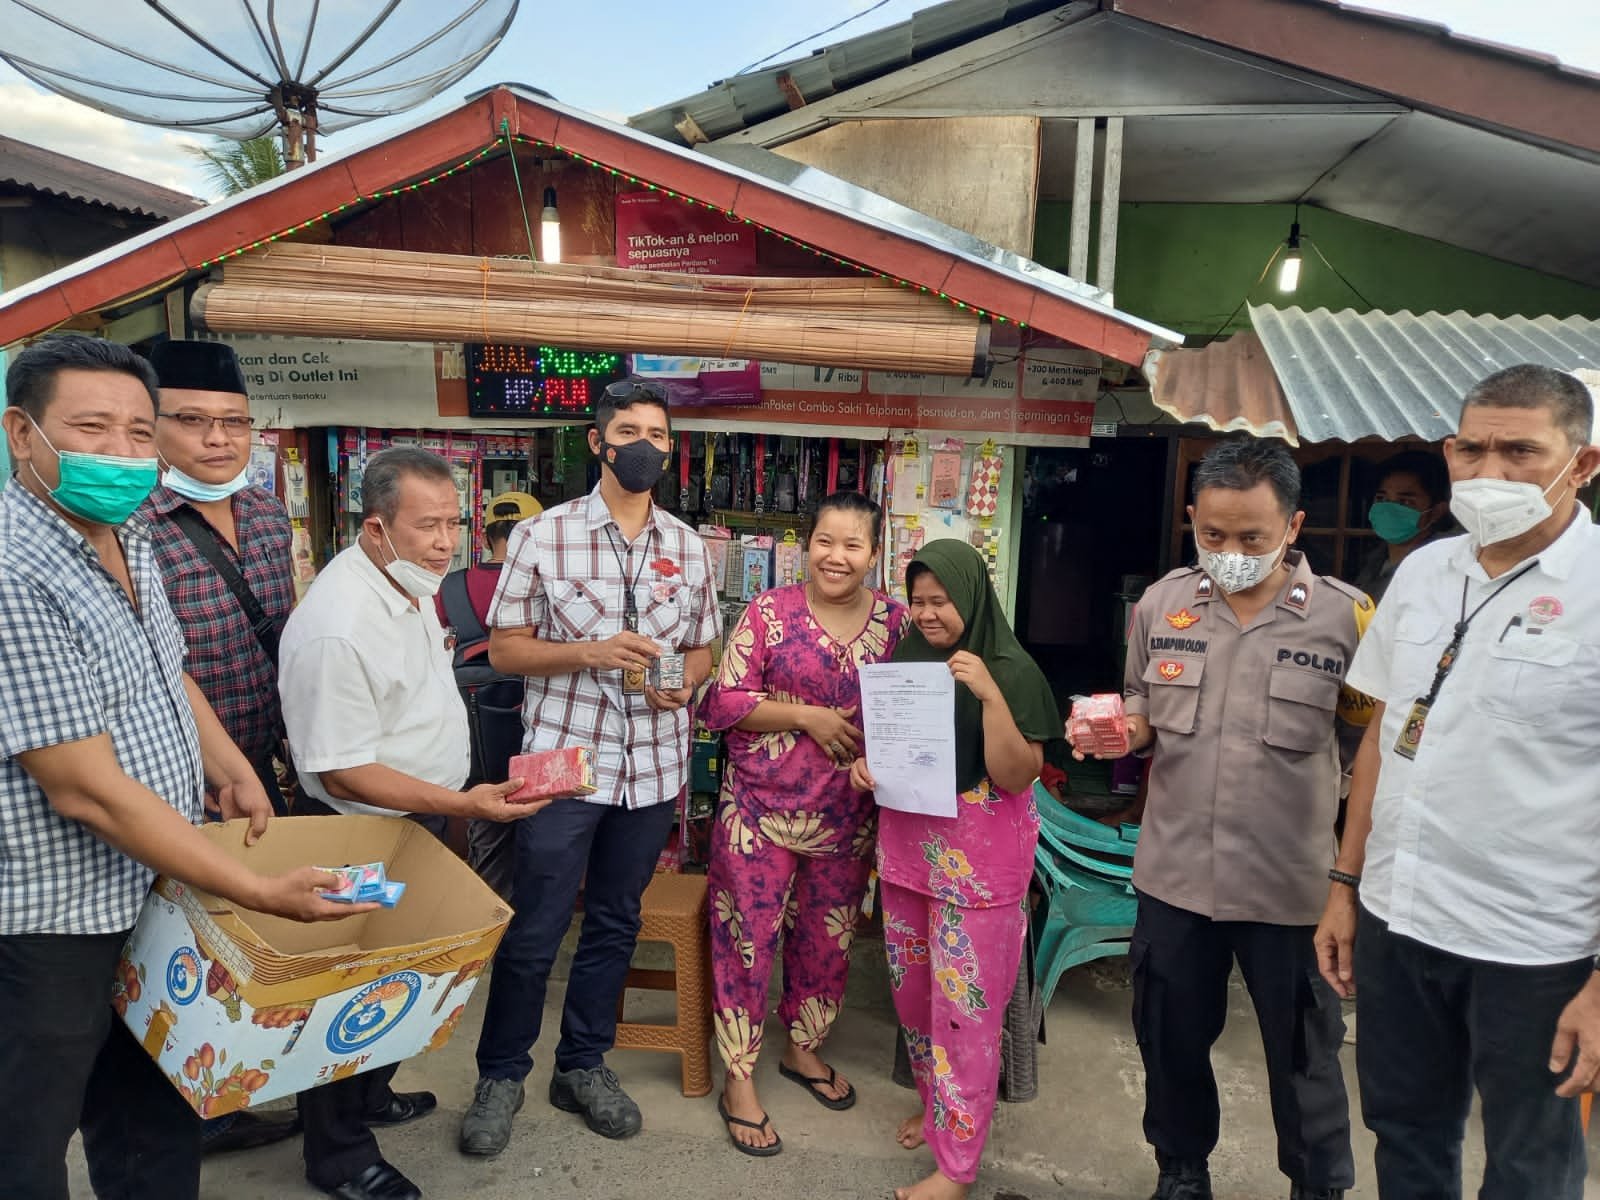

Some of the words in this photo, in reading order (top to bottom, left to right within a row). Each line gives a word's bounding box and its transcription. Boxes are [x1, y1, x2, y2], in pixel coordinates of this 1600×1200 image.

[628, 235, 685, 247] TikTok-an
[687, 233, 697, 243] &
[698, 231, 739, 244] nelpon
[628, 247, 690, 261] sepuasnya
[268, 353, 297, 365] dan
[302, 352, 331, 364] Cek
[269, 370, 284, 383] Di
[288, 369, 334, 383] Outlet
[339, 368, 359, 381] Ini
[838, 372, 859, 382] Ribu
[992, 378, 1014, 389] Ribu
[798, 402, 835, 414] Combo
[838, 402, 862, 415] Sakti
[981, 408, 1001, 419] dan
[1276, 648, 1343, 675] POLRI
[352, 980, 383, 1004] MAN
